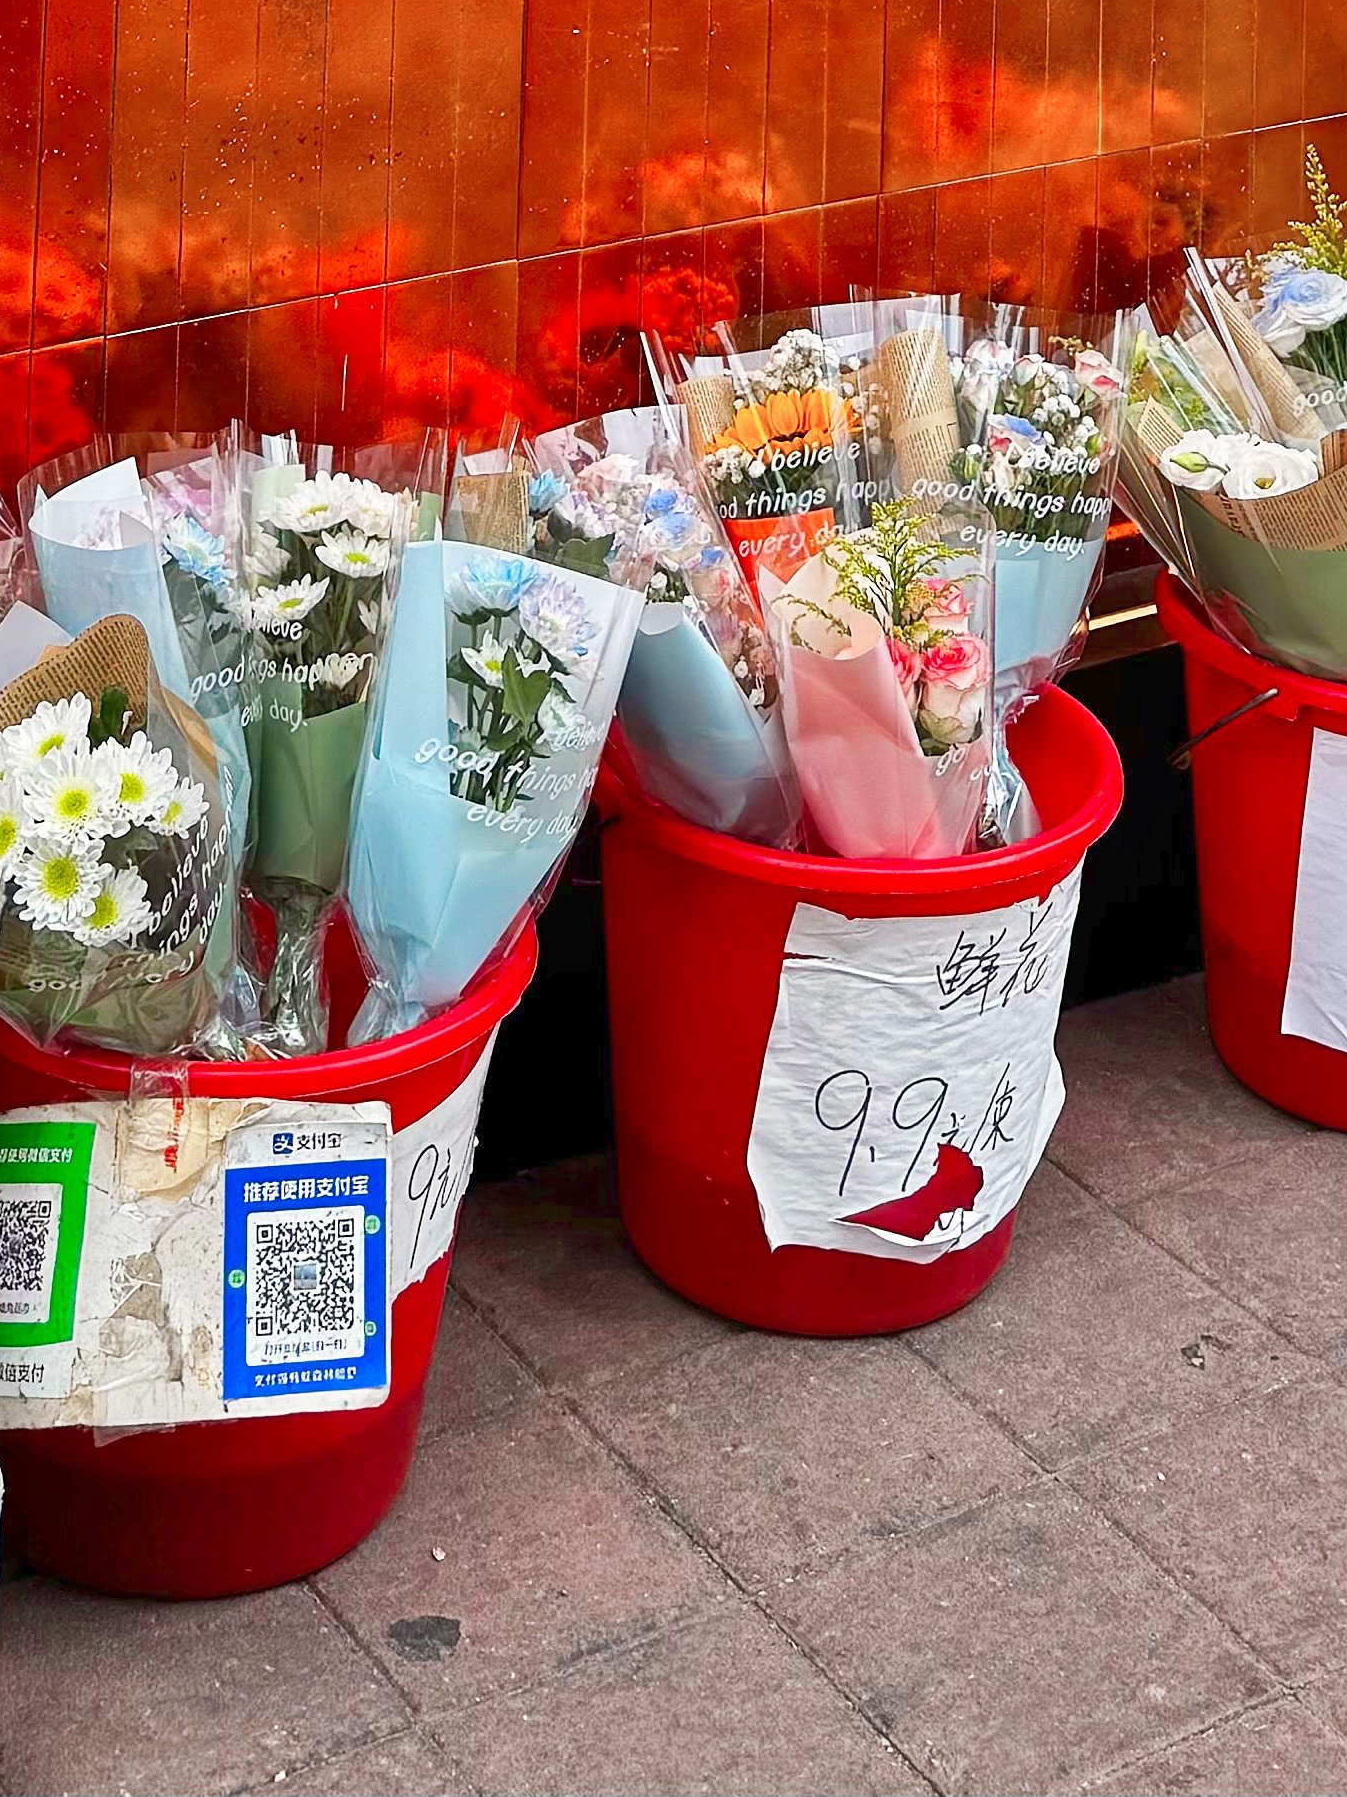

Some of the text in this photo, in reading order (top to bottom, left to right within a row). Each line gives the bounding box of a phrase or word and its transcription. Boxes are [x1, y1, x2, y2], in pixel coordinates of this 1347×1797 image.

[771, 437, 861, 472] believe
[742, 476, 891, 518] things happ
[910, 476, 1112, 521] good things happ
[738, 526, 807, 562] every
[960, 524, 1039, 556] every
[935, 899, 1054, 1016] 鲜花
[242, 1175, 370, 1204] 推荐使用支付宝
